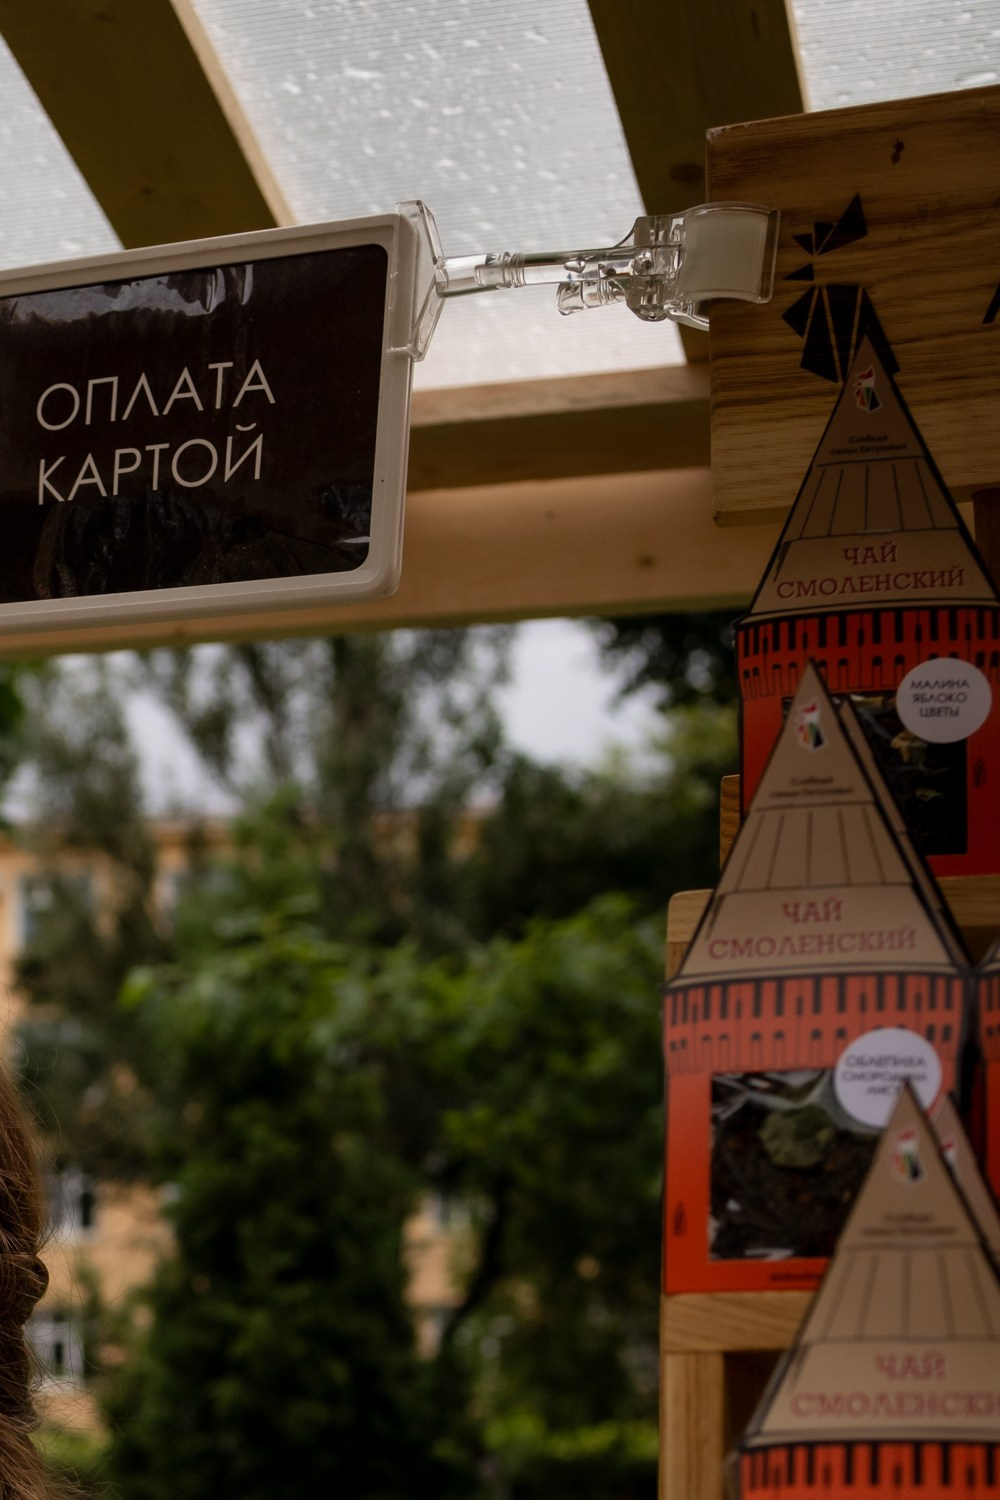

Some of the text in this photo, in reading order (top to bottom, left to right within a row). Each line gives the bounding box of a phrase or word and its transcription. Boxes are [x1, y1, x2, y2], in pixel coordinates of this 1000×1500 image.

[36, 359, 276, 431] ОПЛАТА
[38, 423, 264, 505] КАРТОЙ
[843, 541, 898, 566] ЧАЙ
[776, 565, 965, 599] СМОЛЕНСКИЙ
[910, 679, 970, 689] МАЛИНА
[912, 692, 967, 703] ЯБЛОКО
[919, 706, 960, 718] ЦВЕТЫ
[782, 896, 843, 923] ЧАЙ
[707, 924, 917, 960] СМОЛЕНСКИЙ
[875, 1349, 946, 1380] ЧАЙ
